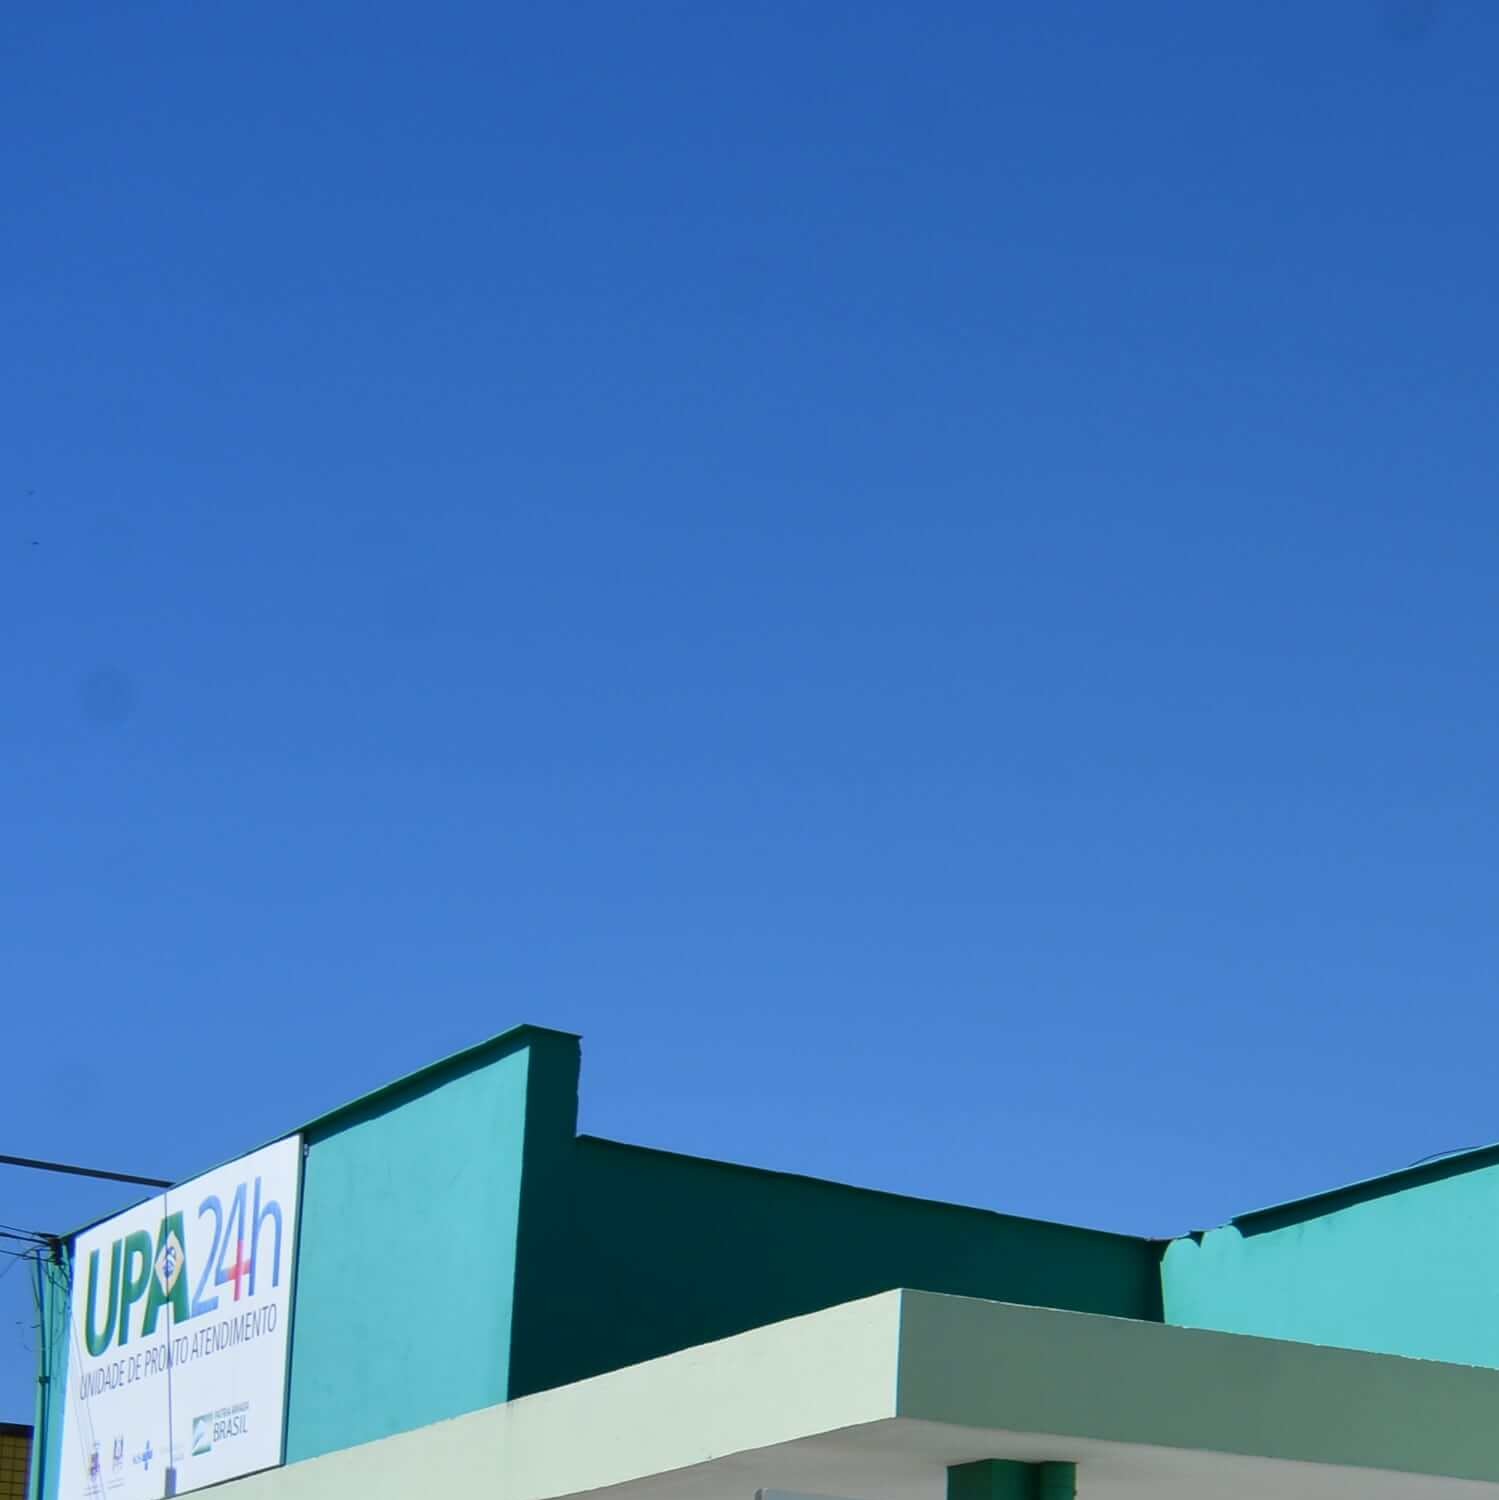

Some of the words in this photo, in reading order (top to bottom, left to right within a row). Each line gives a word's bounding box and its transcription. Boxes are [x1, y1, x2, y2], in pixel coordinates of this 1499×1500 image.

[85, 1210, 191, 1358] UPA
[190, 1176, 283, 1320] 24h
[79, 1359, 126, 1401] UNIDADE
[127, 1351, 144, 1384] DE
[144, 1334, 189, 1375] PRONTO
[189, 1303, 278, 1362] ATENDIMENTO
[212, 1413, 249, 1443] BRASIL
